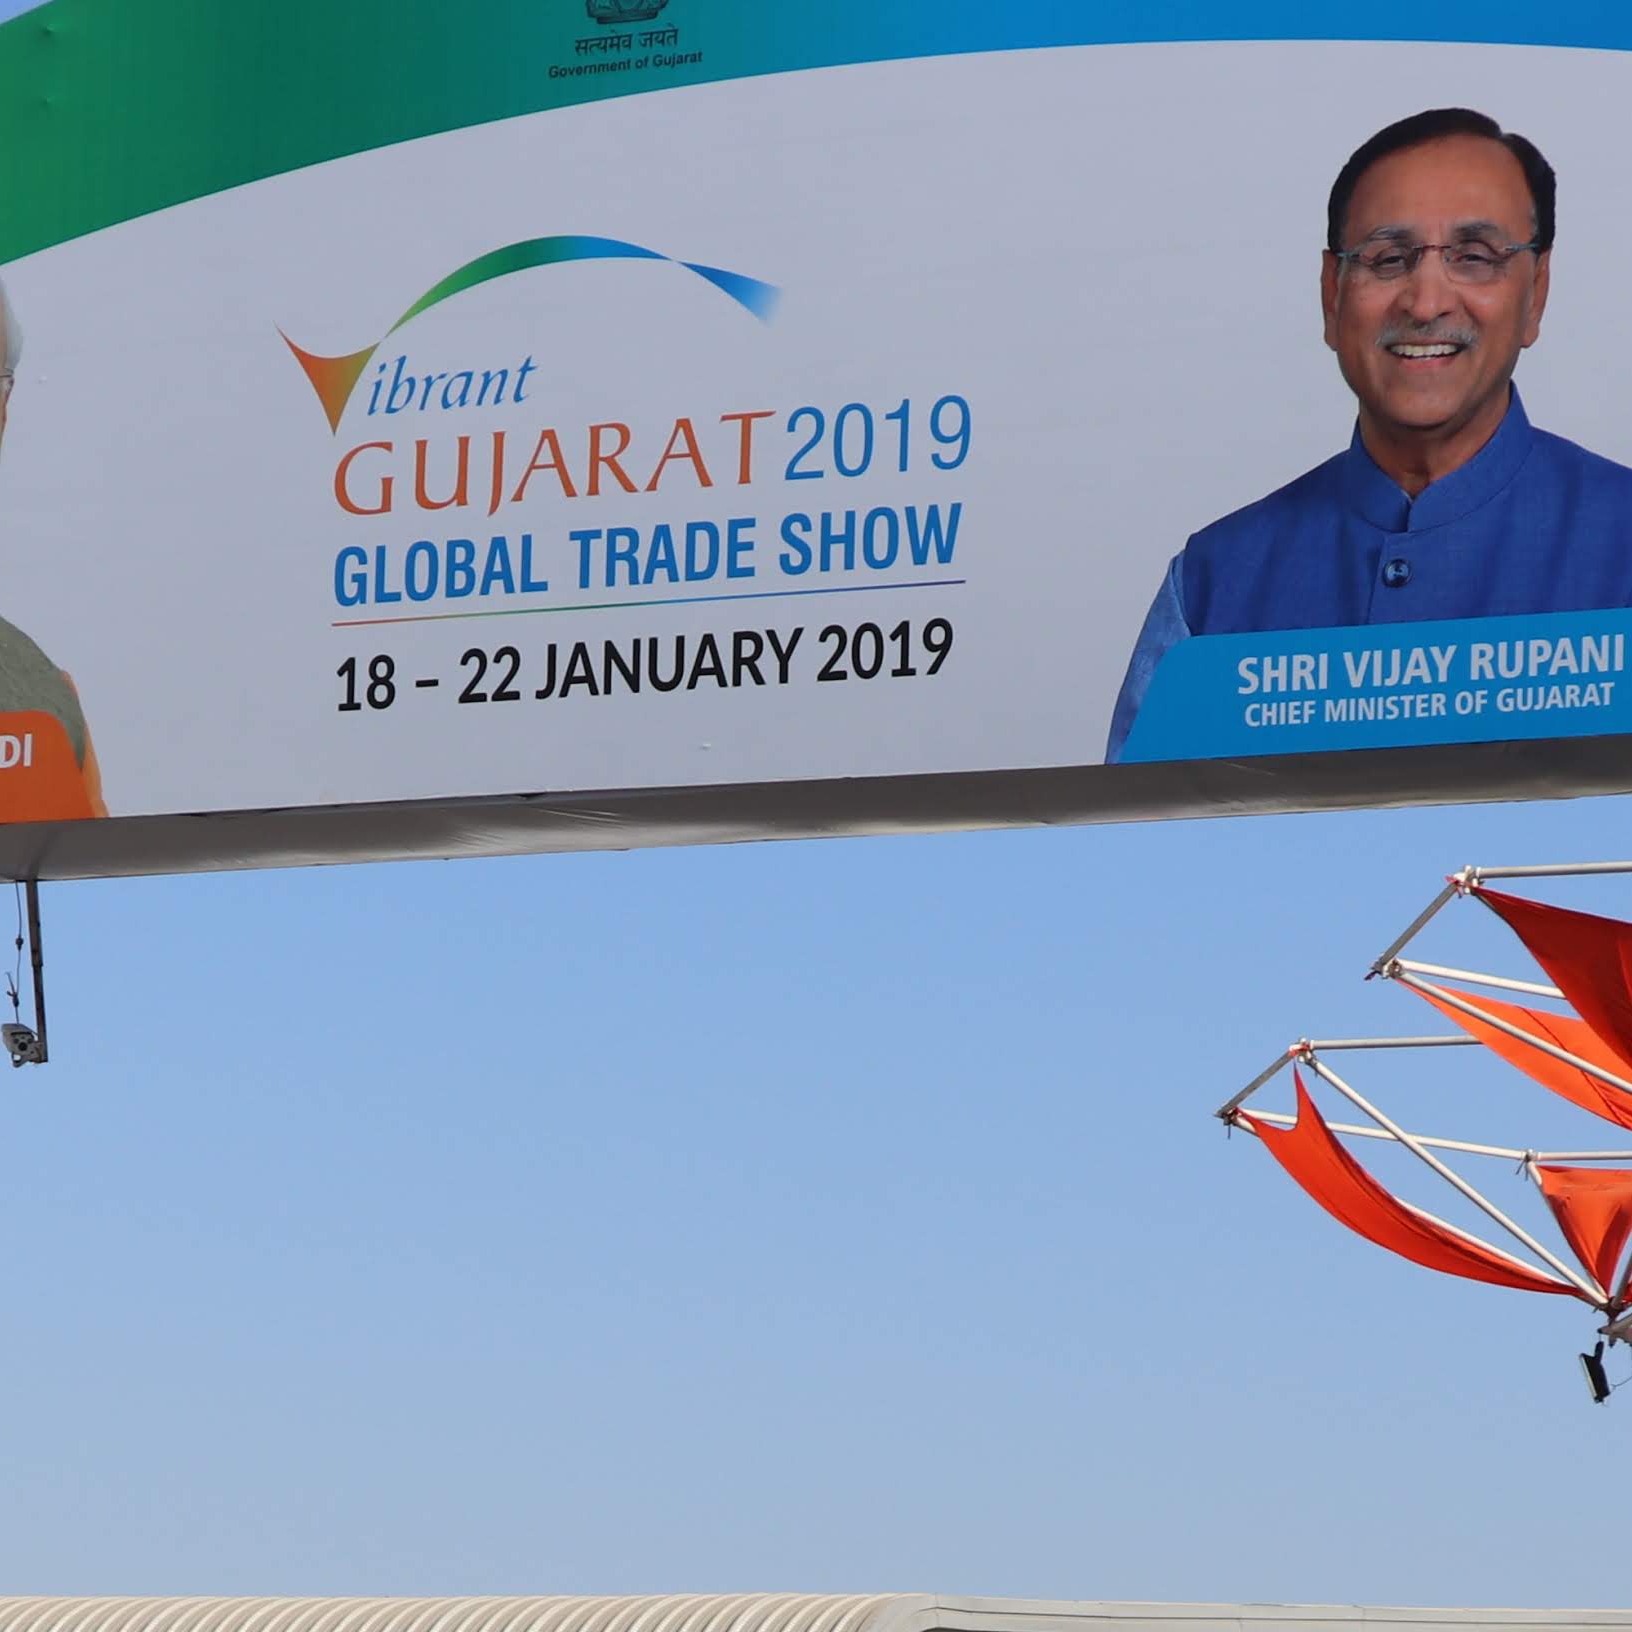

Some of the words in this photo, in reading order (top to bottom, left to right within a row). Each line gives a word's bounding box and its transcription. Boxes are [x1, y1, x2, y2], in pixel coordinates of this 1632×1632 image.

[548, 58, 631, 78] Government
[635, 54, 649, 69] of
[652, 51, 703, 68] Gujarat
[638, 24, 679, 48] जयते
[333, 410, 776, 517] GUJARAT
[783, 395, 971, 481] 2019
[333, 533, 548, 607] GLOBAL
[569, 517, 756, 589] TRADE
[779, 502, 962, 575] SHOW
[336, 654, 396, 712] 18
[458, 646, 521, 704] 22
[534, 627, 805, 701] JANUARY
[817, 617, 954, 682] 2019
[1237, 653, 1328, 694] SHRI
[1343, 645, 1457, 687] VIJAY
[1470, 634, 1624, 680] RUPANI
[1244, 701, 1316, 727] CHIEF
[1324, 692, 1446, 723] MINISTER
[1455, 690, 1488, 714] OF
[1496, 682, 1615, 712] GUJARAT
